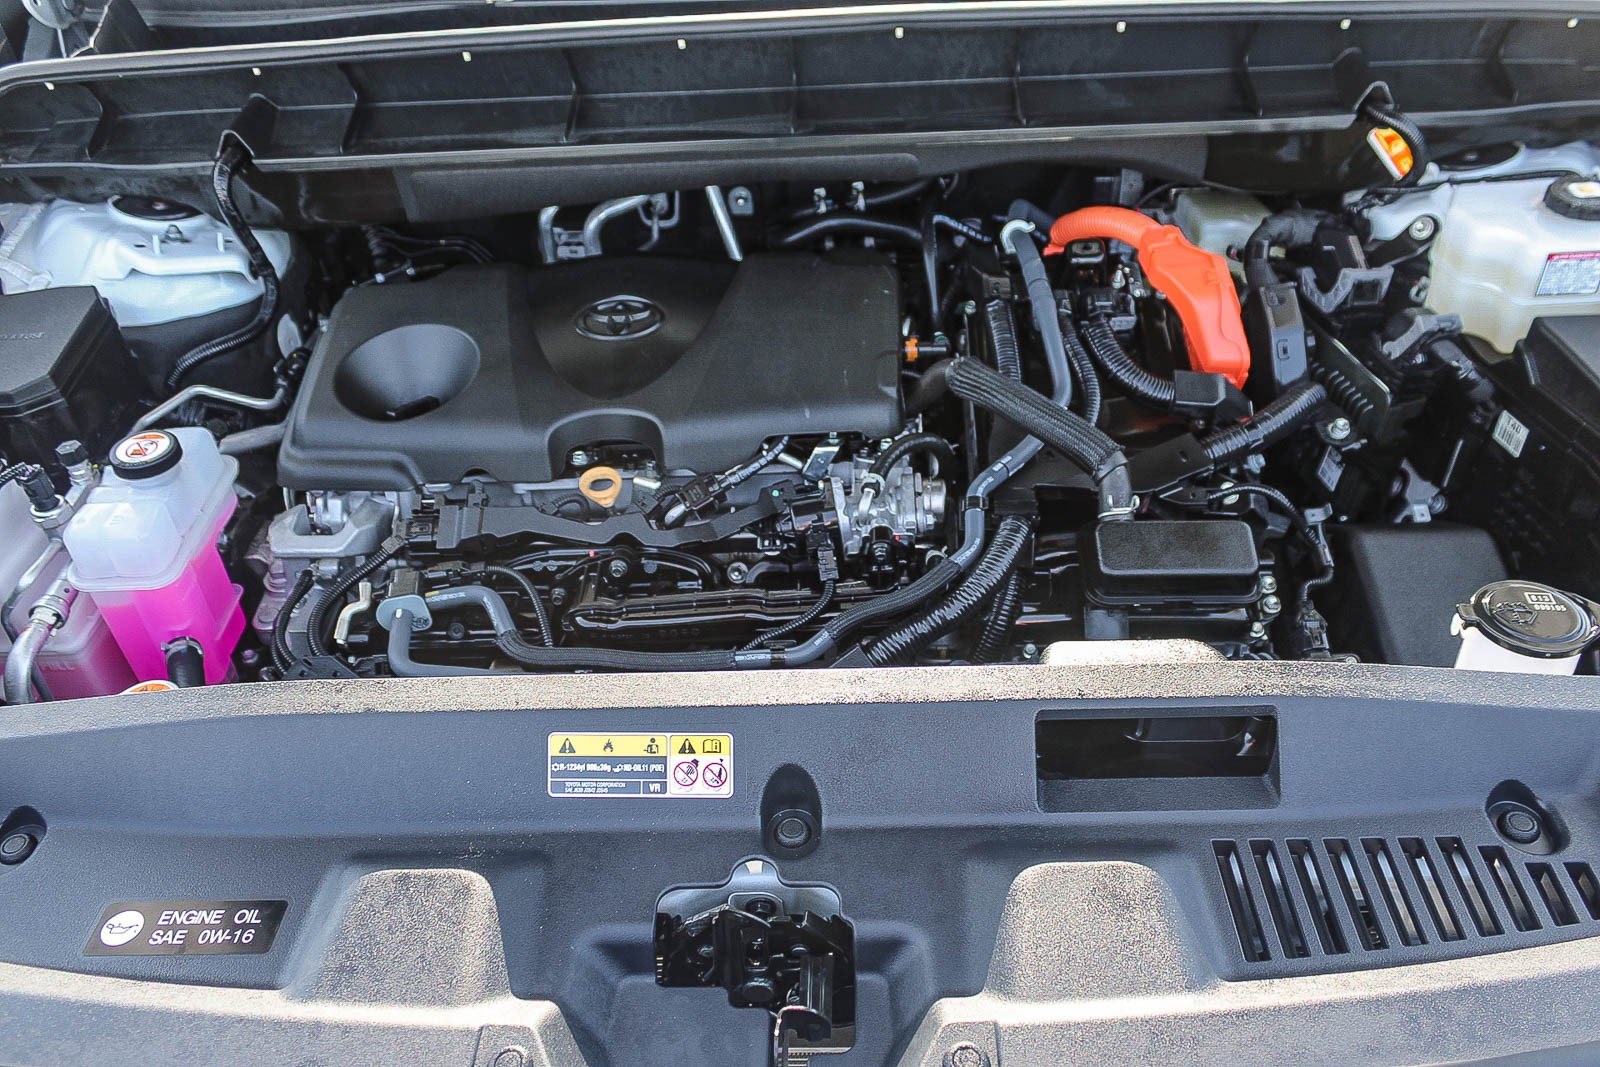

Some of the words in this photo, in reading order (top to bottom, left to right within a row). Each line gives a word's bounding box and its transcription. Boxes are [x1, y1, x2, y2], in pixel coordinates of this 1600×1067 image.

[157, 909, 226, 925] ENGINE
[233, 909, 262, 925] OIL
[148, 929, 189, 945] SAE
[198, 929, 256, 944] 0W-16
